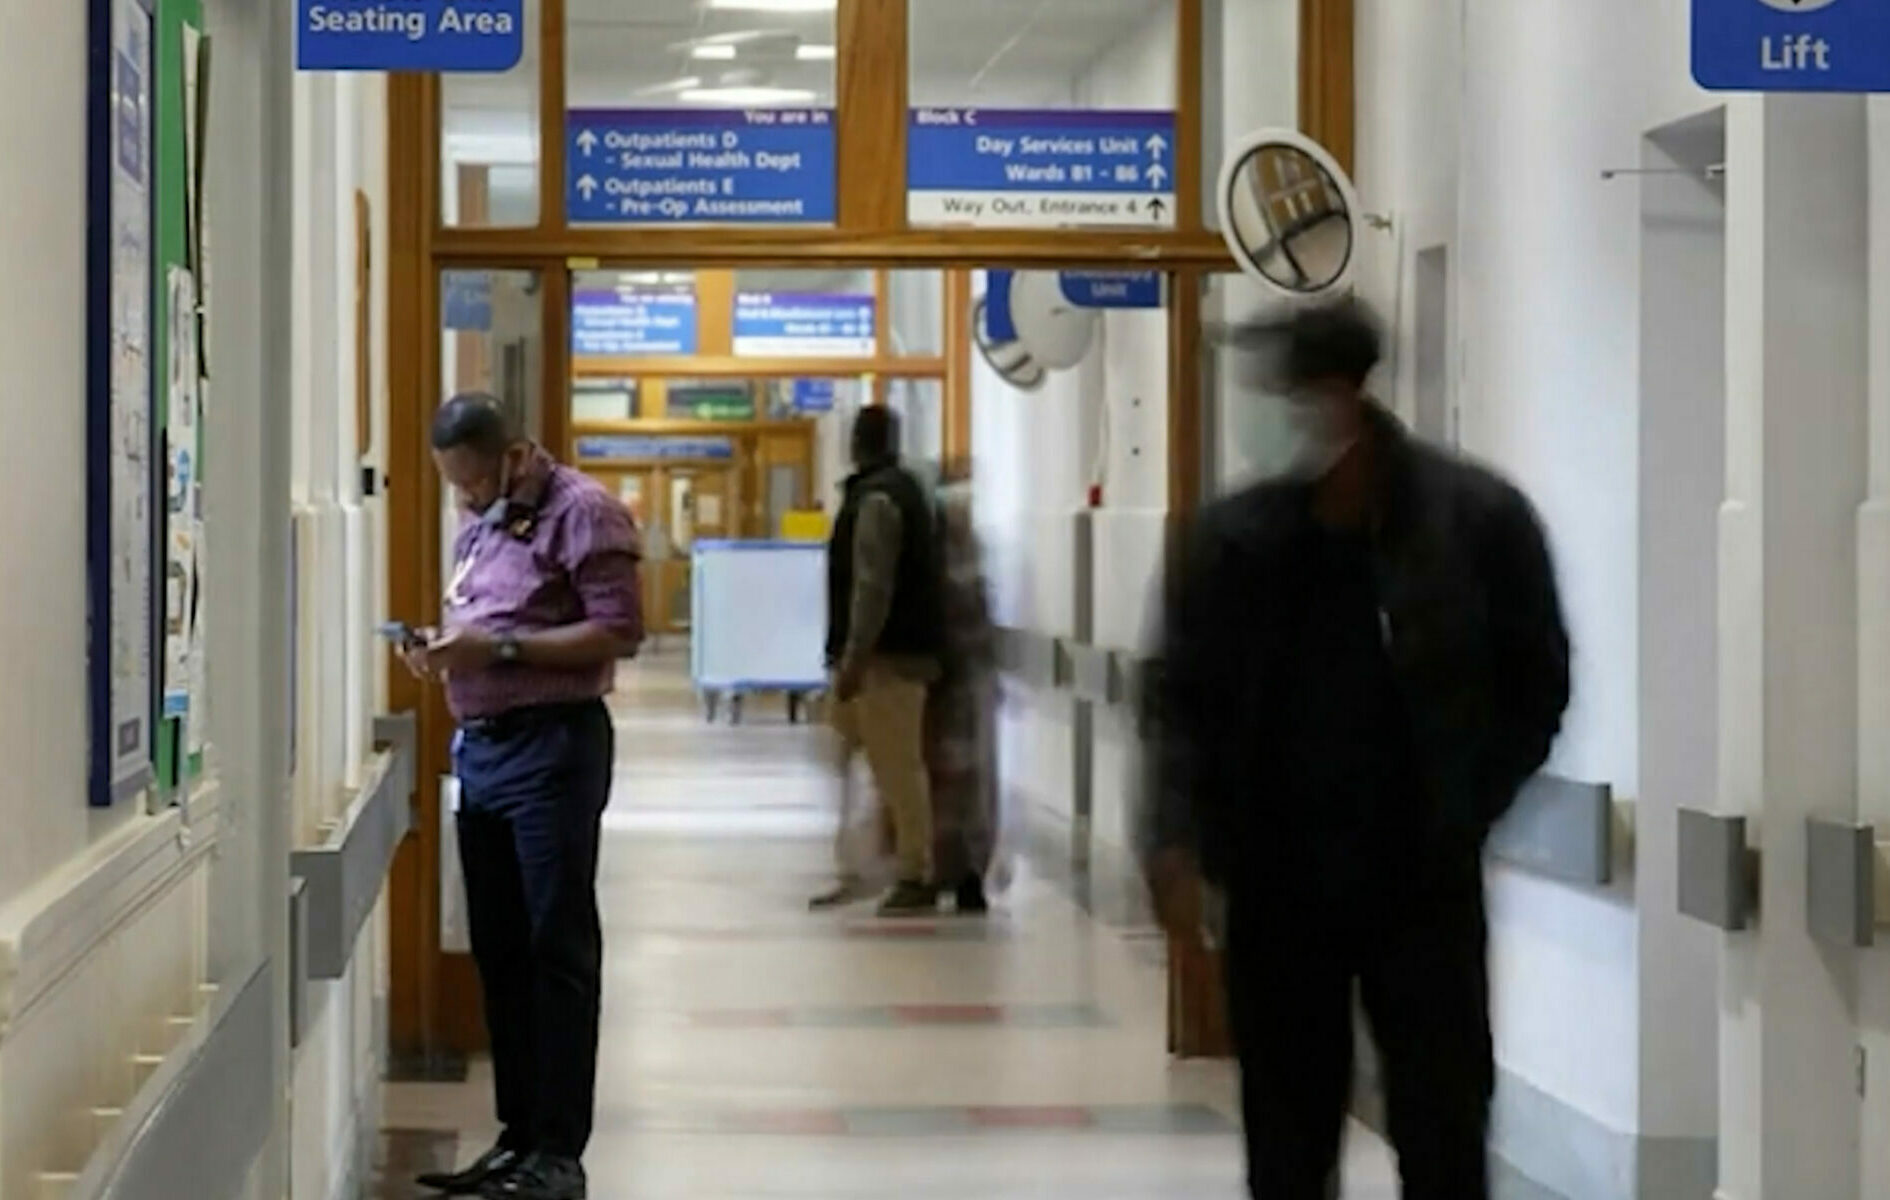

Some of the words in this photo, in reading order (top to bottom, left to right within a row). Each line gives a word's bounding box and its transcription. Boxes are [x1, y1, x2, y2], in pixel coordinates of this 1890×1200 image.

[309, 6, 426, 40] Seating
[438, 6, 513, 33] Area
[1761, 34, 1830, 70] Lift
[745, 109, 775, 124] You
[781, 111, 806, 124] are
[812, 109, 829, 124] in
[916, 109, 960, 125] Block
[964, 109, 977, 126] C
[604, 131, 716, 151] Outpatients
[722, 132, 738, 149] D
[976, 136, 1014, 157] Day
[1020, 136, 1093, 155] Services
[1099, 137, 1139, 155] Unit
[620, 151, 682, 169] Sexual
[688, 151, 750, 169] Health
[755, 151, 802, 171] Dept
[1005, 164, 1065, 182] Wards
[1071, 165, 1093, 182] B1
[604, 177, 717, 197] Outpatients
[722, 178, 734, 195] E
[620, 198, 687, 217] Pre-Op
[693, 198, 804, 215] Assessment
[942, 198, 985, 215] Way
[991, 198, 1033, 215] Out,
[1039, 198, 1119, 214] Entrance
[1125, 199, 1138, 214] 4
